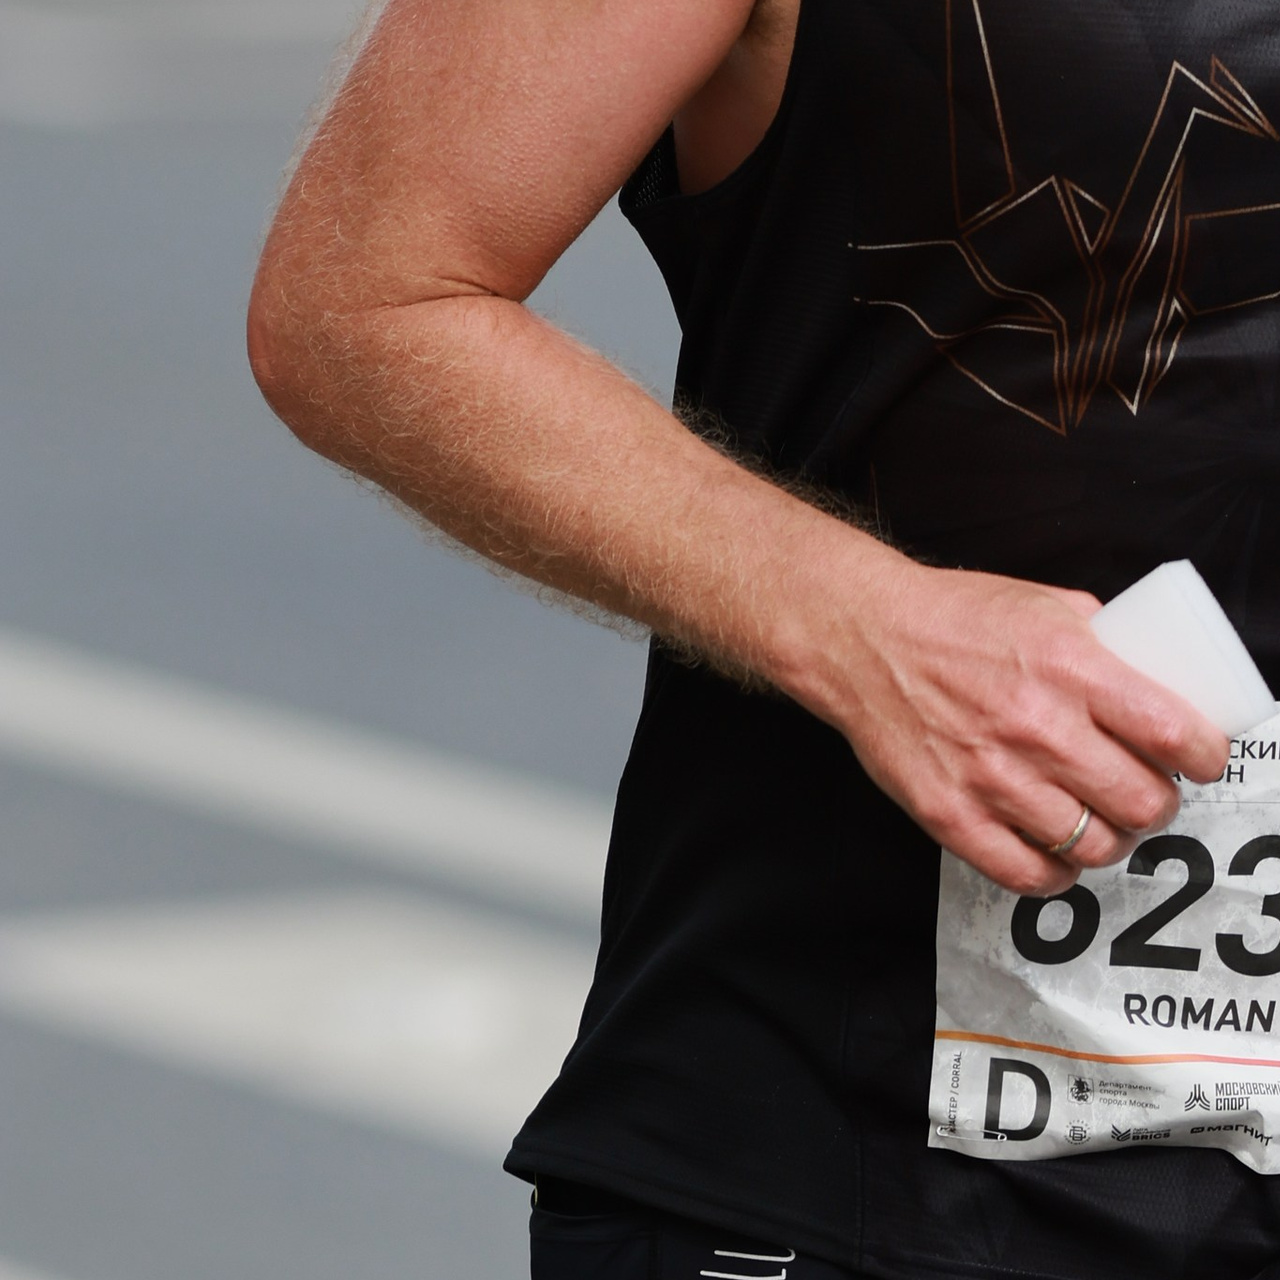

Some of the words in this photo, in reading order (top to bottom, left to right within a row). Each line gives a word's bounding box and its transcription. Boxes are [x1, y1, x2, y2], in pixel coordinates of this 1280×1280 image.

[1123, 993, 1277, 1033] ROMAN
[950, 1051, 963, 1090] CORRAL
[983, 1056, 1052, 1142] D
[1215, 1096, 1251, 1112] СПОРТ
